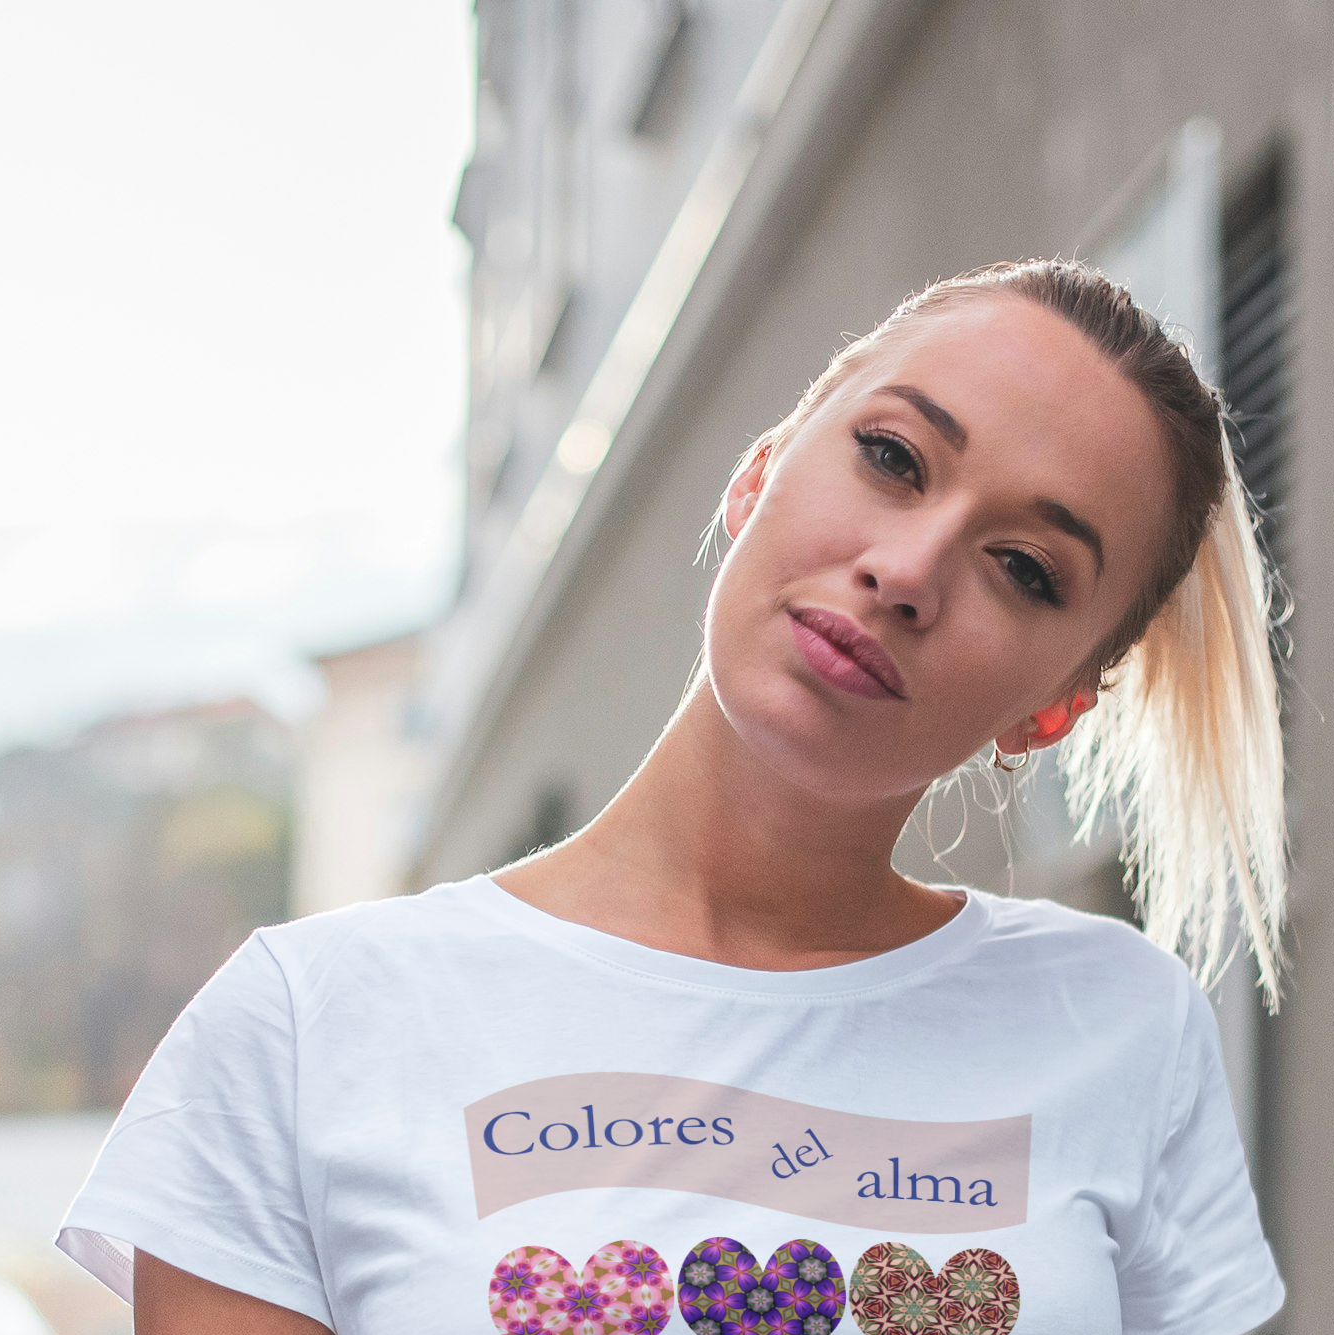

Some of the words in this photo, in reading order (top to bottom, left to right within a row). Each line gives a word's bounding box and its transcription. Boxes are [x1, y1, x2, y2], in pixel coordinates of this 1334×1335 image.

[483, 1104, 735, 1156] Colores
[771, 1128, 834, 1179] del
[856, 1157, 998, 1207] alma
